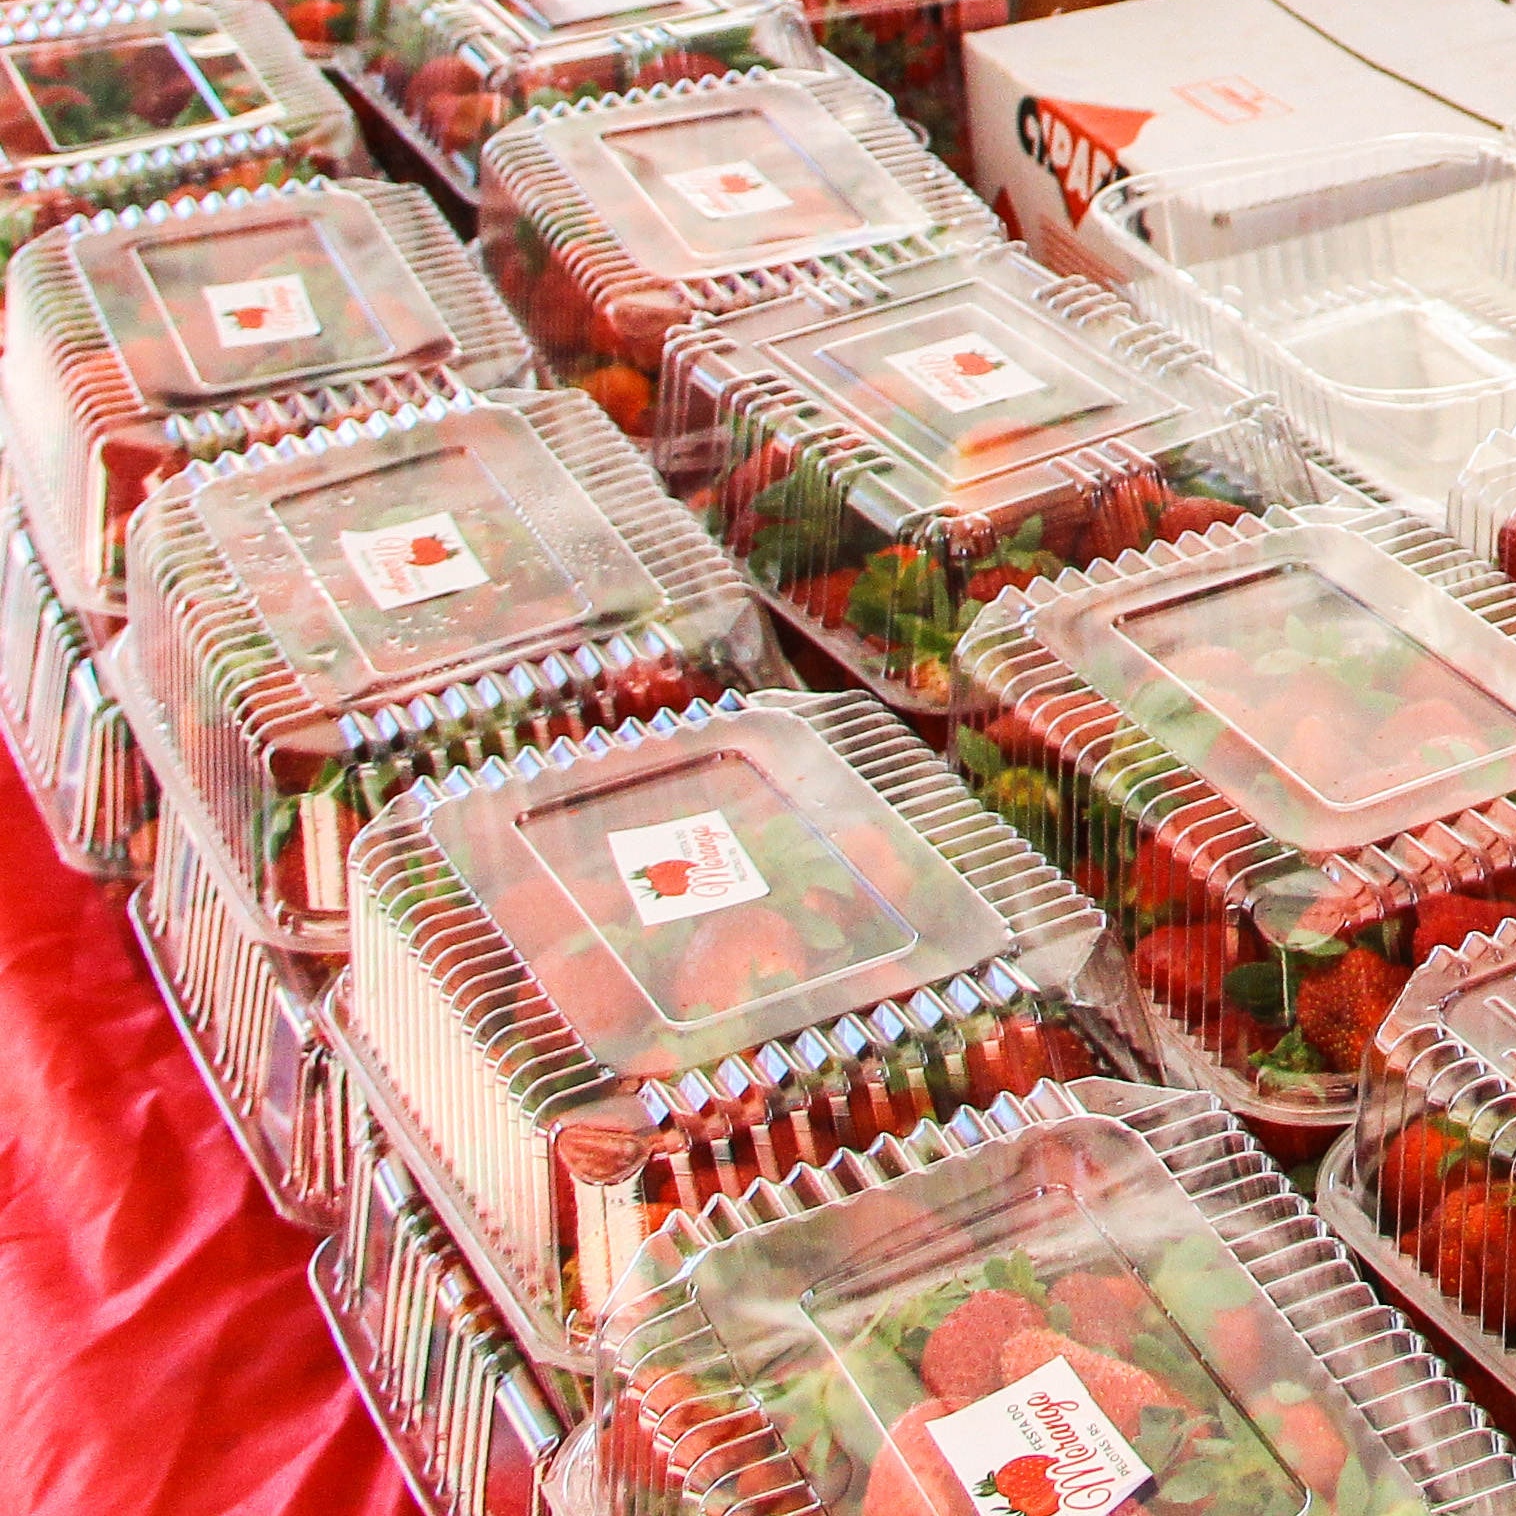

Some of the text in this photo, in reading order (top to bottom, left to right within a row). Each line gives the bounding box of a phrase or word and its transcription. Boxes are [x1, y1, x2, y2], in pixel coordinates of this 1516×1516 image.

[1007, 1403, 1046, 1452] FESTA DO
[1086, 1422, 1098, 1437] RS
[1027, 1391, 1116, 1510] Morango
[1097, 1439, 1132, 1478] PELOTAS
